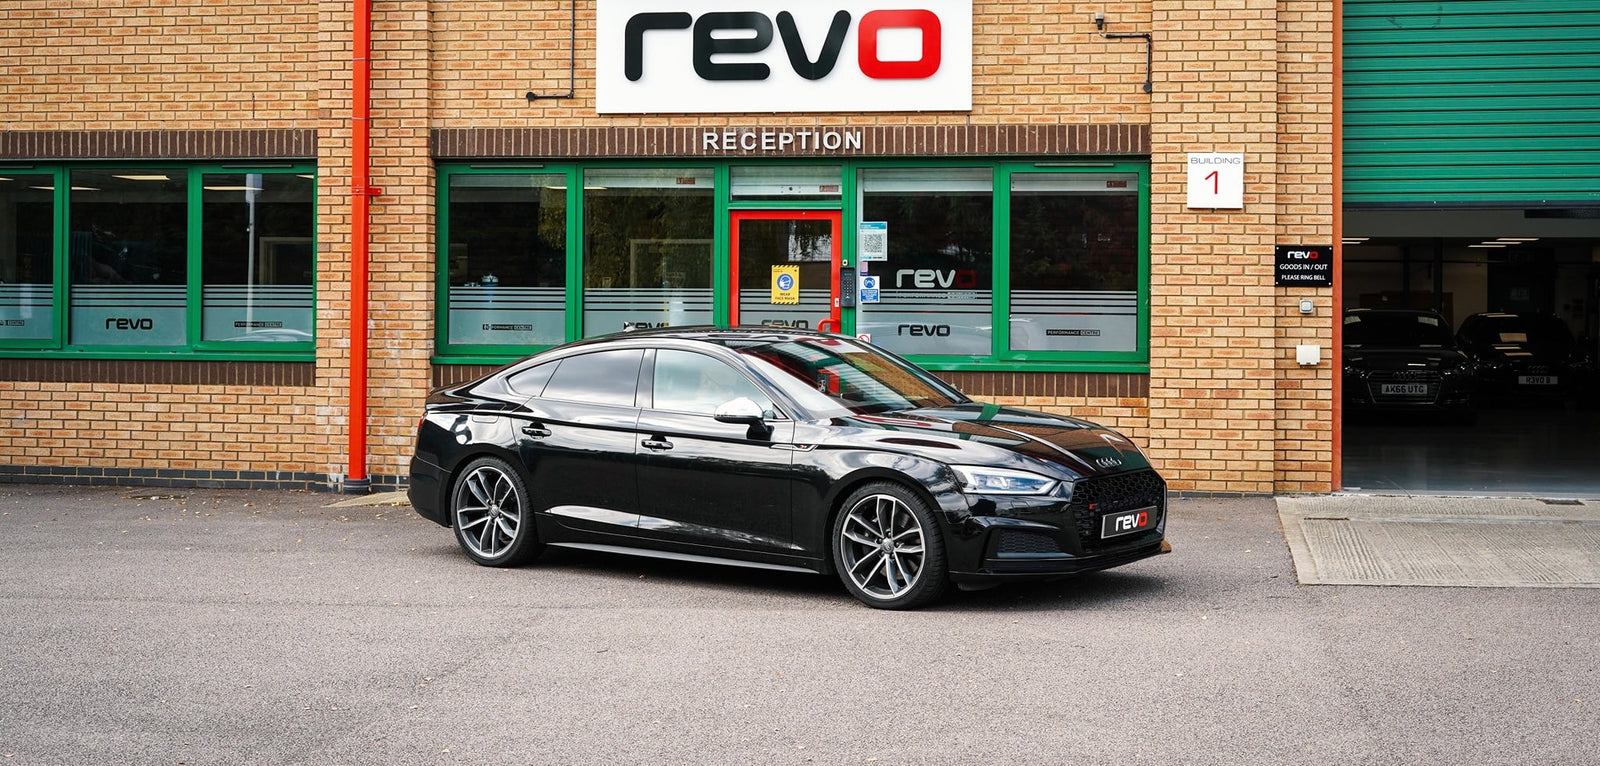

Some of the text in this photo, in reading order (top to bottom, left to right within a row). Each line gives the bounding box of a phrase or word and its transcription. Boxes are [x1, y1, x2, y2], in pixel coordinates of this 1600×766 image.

[624, 9, 942, 82] revo
[702, 131, 863, 151] RECEPTION
[1190, 157, 1241, 165] BUILDING
[1204, 170, 1218, 195] 1
[1287, 250, 1319, 259] revo
[896, 269, 977, 288] revo
[105, 318, 153, 330] revo
[898, 324, 951, 337] revo
[1385, 385, 1424, 393] AK66 UTG
[1115, 512, 1148, 531] revo
